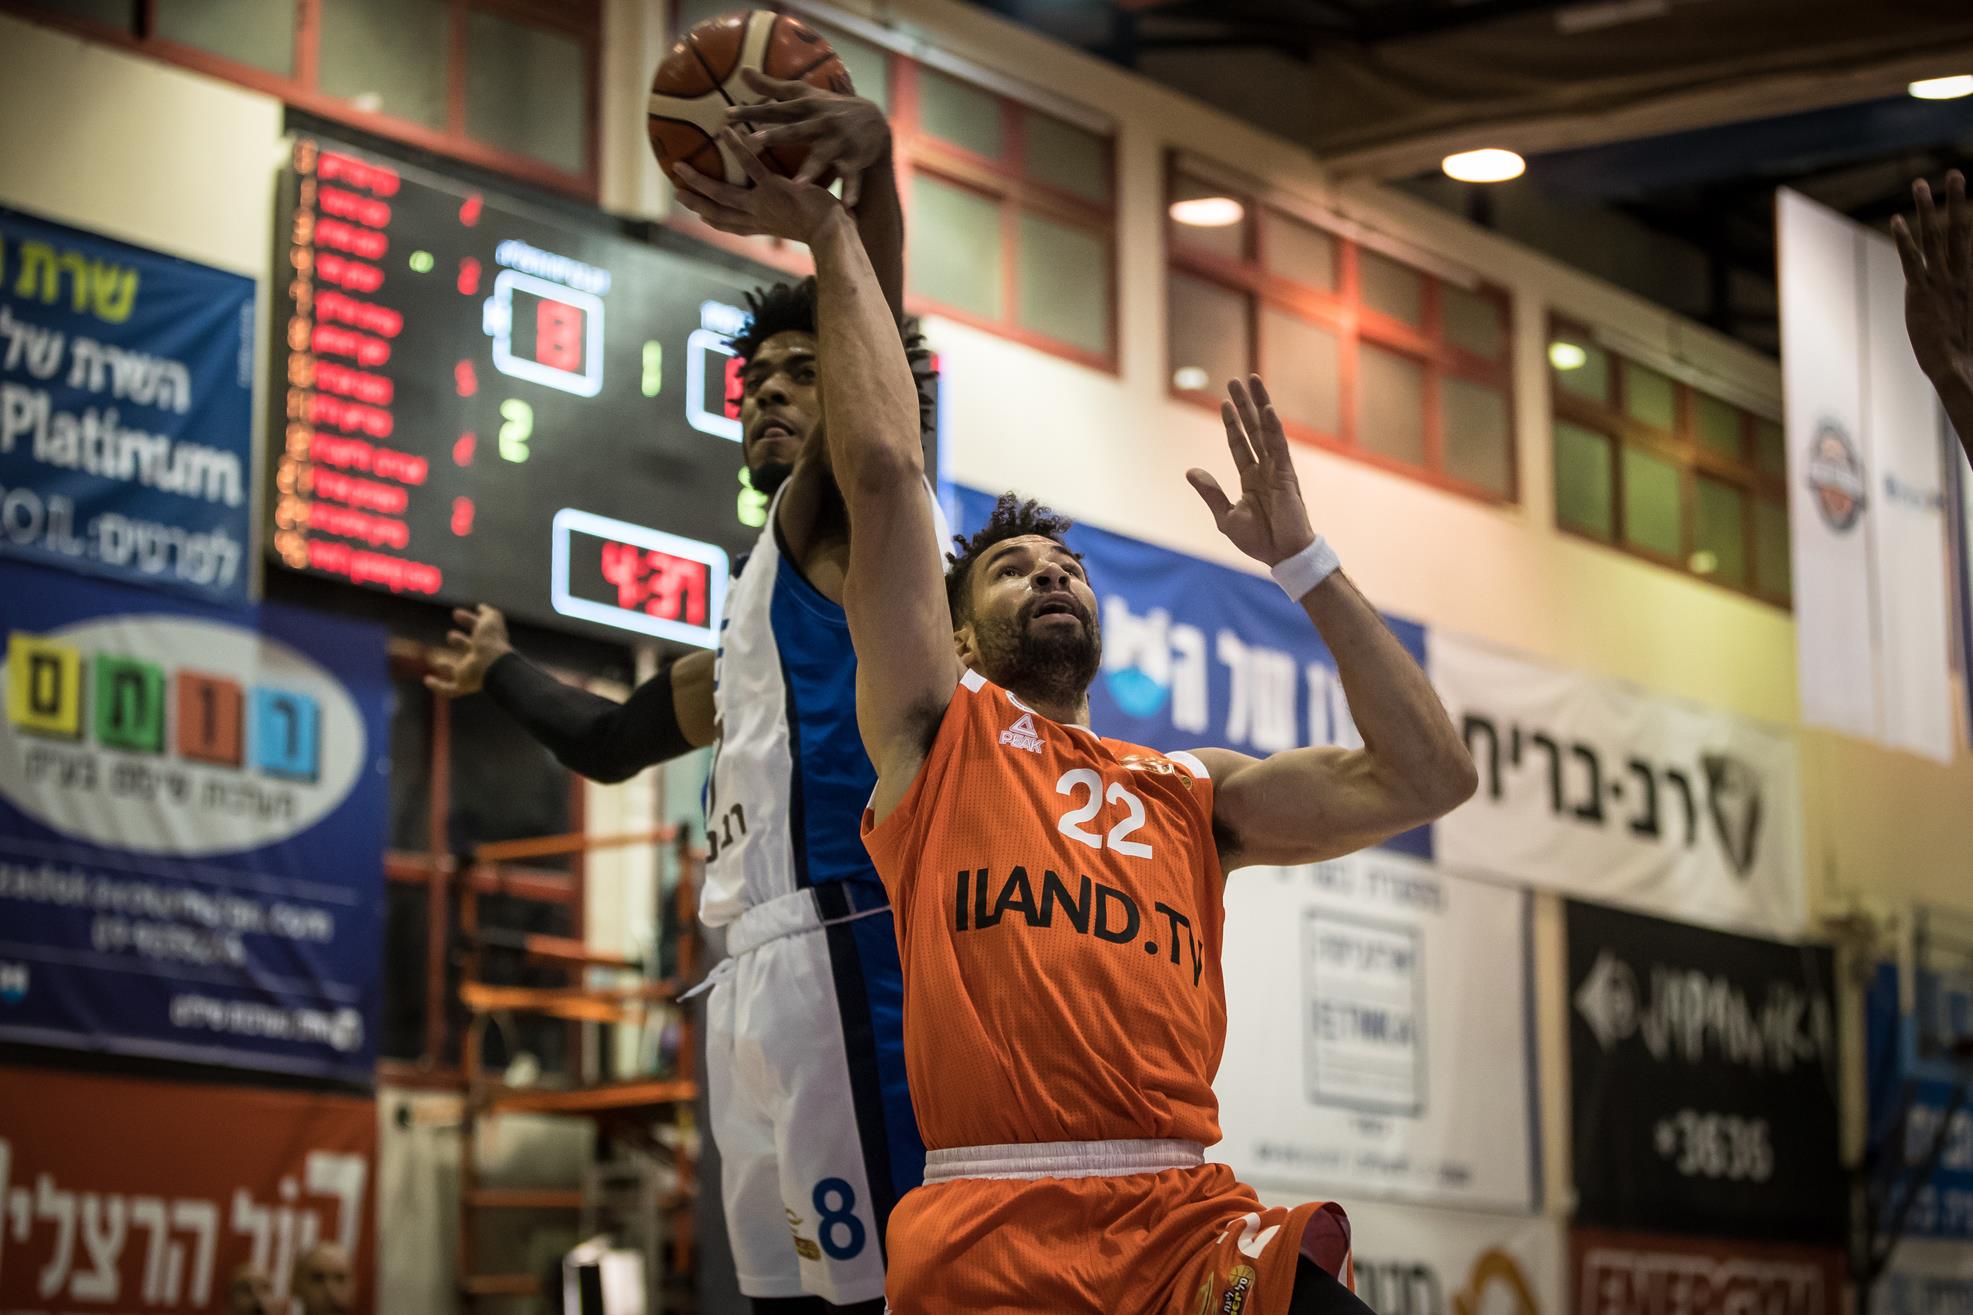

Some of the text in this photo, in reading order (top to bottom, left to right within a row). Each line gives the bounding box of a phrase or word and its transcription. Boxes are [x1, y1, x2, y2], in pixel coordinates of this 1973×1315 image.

[0, 383, 244, 509] Platinum
[999, 730, 1047, 754] PEAK
[1055, 767, 1153, 860] 22
[955, 864, 1204, 989] ILAND.TV
[812, 1176, 867, 1262] 8
